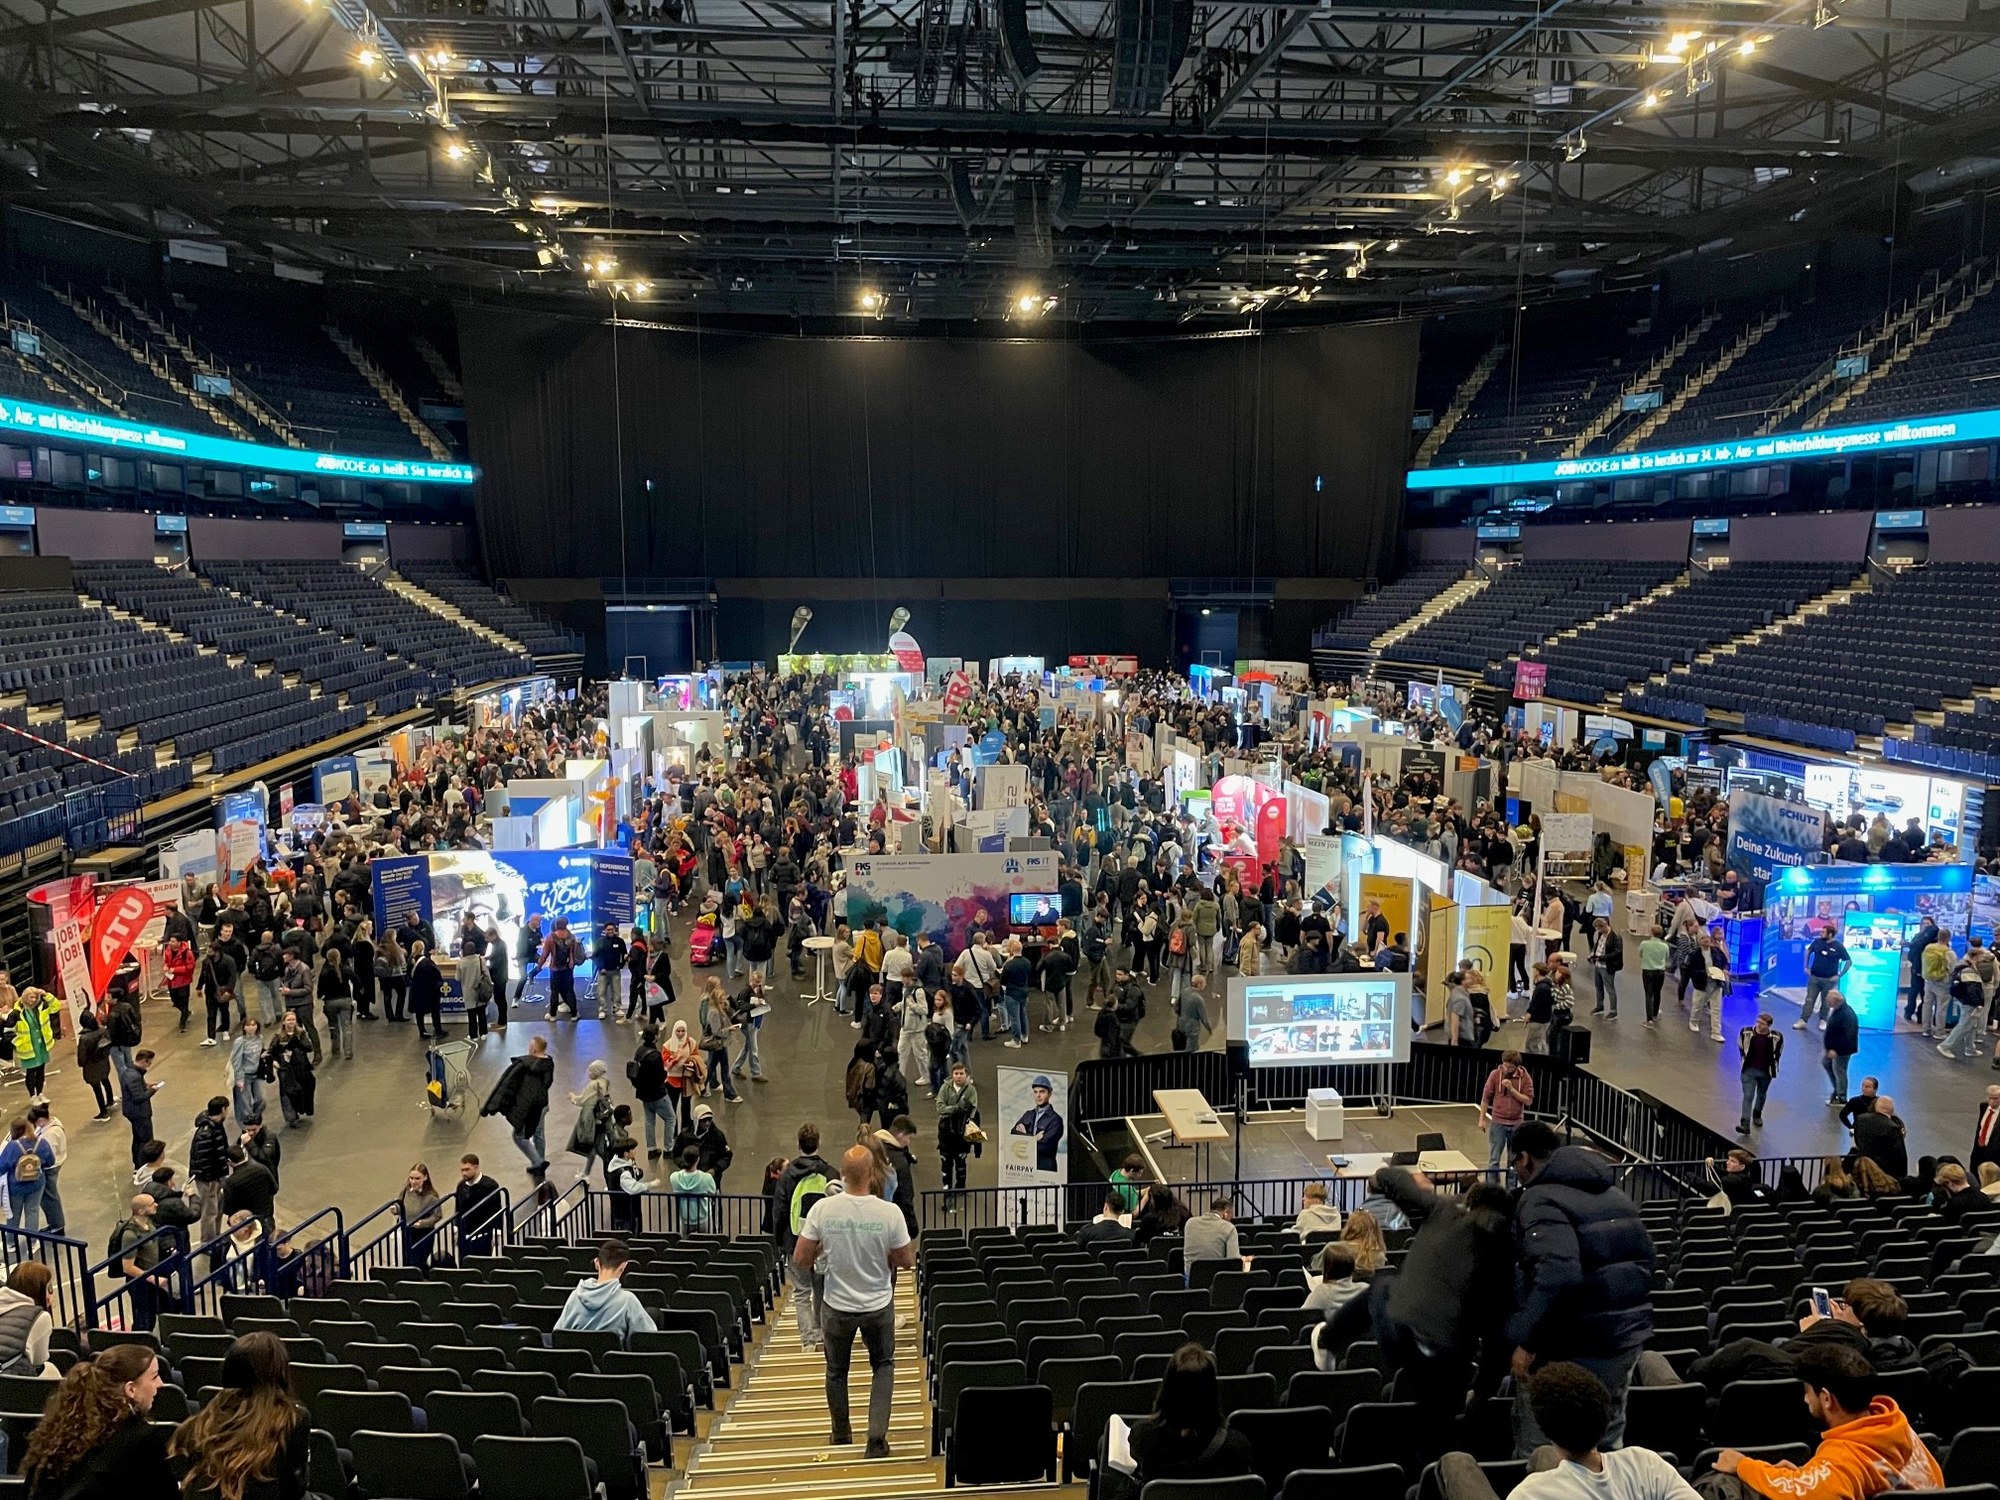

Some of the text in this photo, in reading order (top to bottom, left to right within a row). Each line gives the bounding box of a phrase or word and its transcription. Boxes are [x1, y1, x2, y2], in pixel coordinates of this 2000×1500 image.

[15, 406, 37, 425] Aus-
[38, 412, 57, 429] und
[58, 414, 144, 444] Weiterbildungsmesse
[144, 430, 186, 450] willkommen
[1554, 460, 1620, 476] JOBWOCHE.de
[1621, 454, 1641, 471] heißt
[1641, 455, 1654, 469] Sie
[1654, 452, 1685, 468] herzlich
[1685, 452, 1699, 464] zur
[1700, 449, 1713, 463] 34.
[1735, 445, 1754, 458] Aus-
[1757, 440, 1774, 456] und
[1776, 430, 1880, 453] Weiterbildungsmesse
[1884, 422, 1956, 442] willkommen
[315, 455, 381, 473] JOBWOCHE.de
[382, 460, 409, 476] heißt
[411, 464, 425, 477] Sie
[427, 465, 463, 479] herzlich
[1027, 858, 1050, 866] FKS IT
[1736, 835, 1802, 866] Deine Zukunft
[855, 862, 871, 871] FKS
[1753, 866, 1772, 880] star
[153, 882, 179, 893] BILDEN
[56, 923, 78, 950] JOB?
[101, 896, 143, 965] ATU
[60, 941, 82, 969] JOB!
[1006, 1163, 1034, 1173] FAIRPAY
